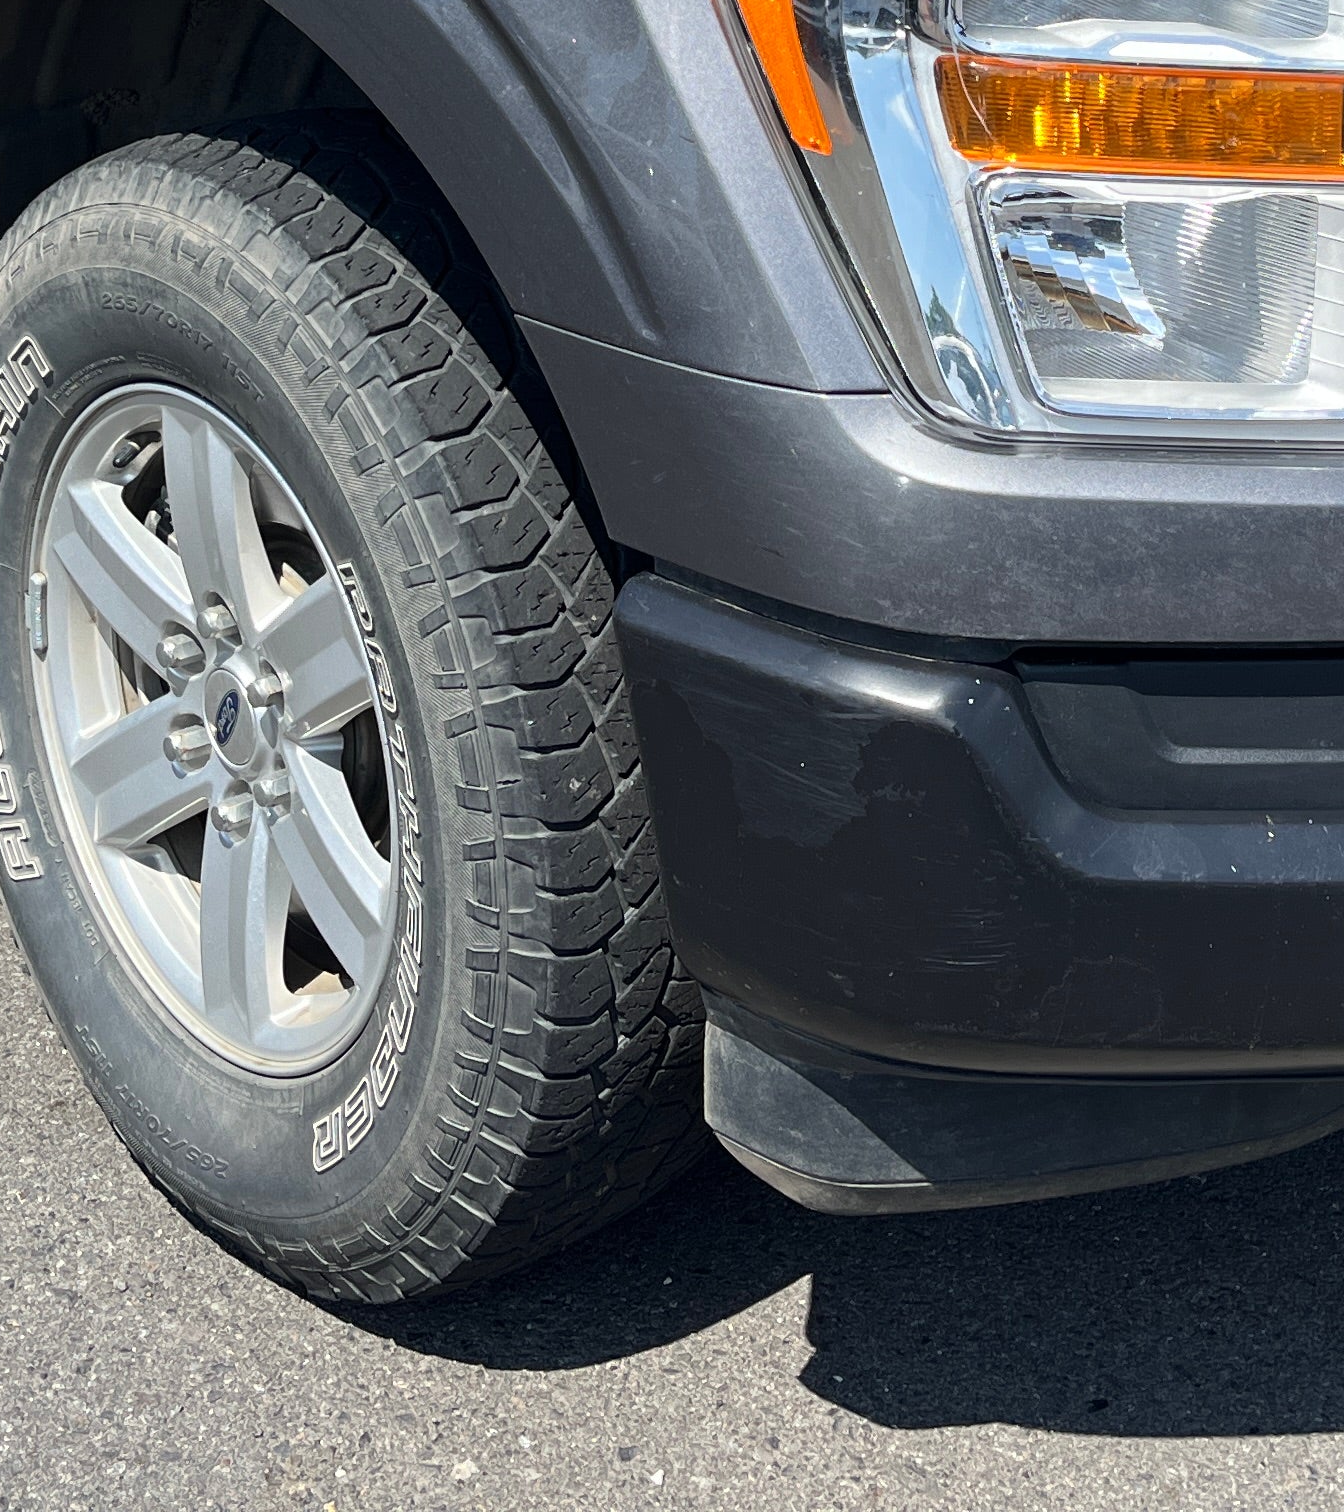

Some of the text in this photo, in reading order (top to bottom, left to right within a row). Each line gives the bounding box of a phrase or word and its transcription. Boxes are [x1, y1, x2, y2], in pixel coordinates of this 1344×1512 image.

[101, 291, 214, 351] 265/70R17
[221, 352, 265, 400] 115T
[312, 563, 424, 1173] PATHFINDER
[74, 1024, 113, 1077] 115T
[115, 1083, 229, 1180] 265/70R17
